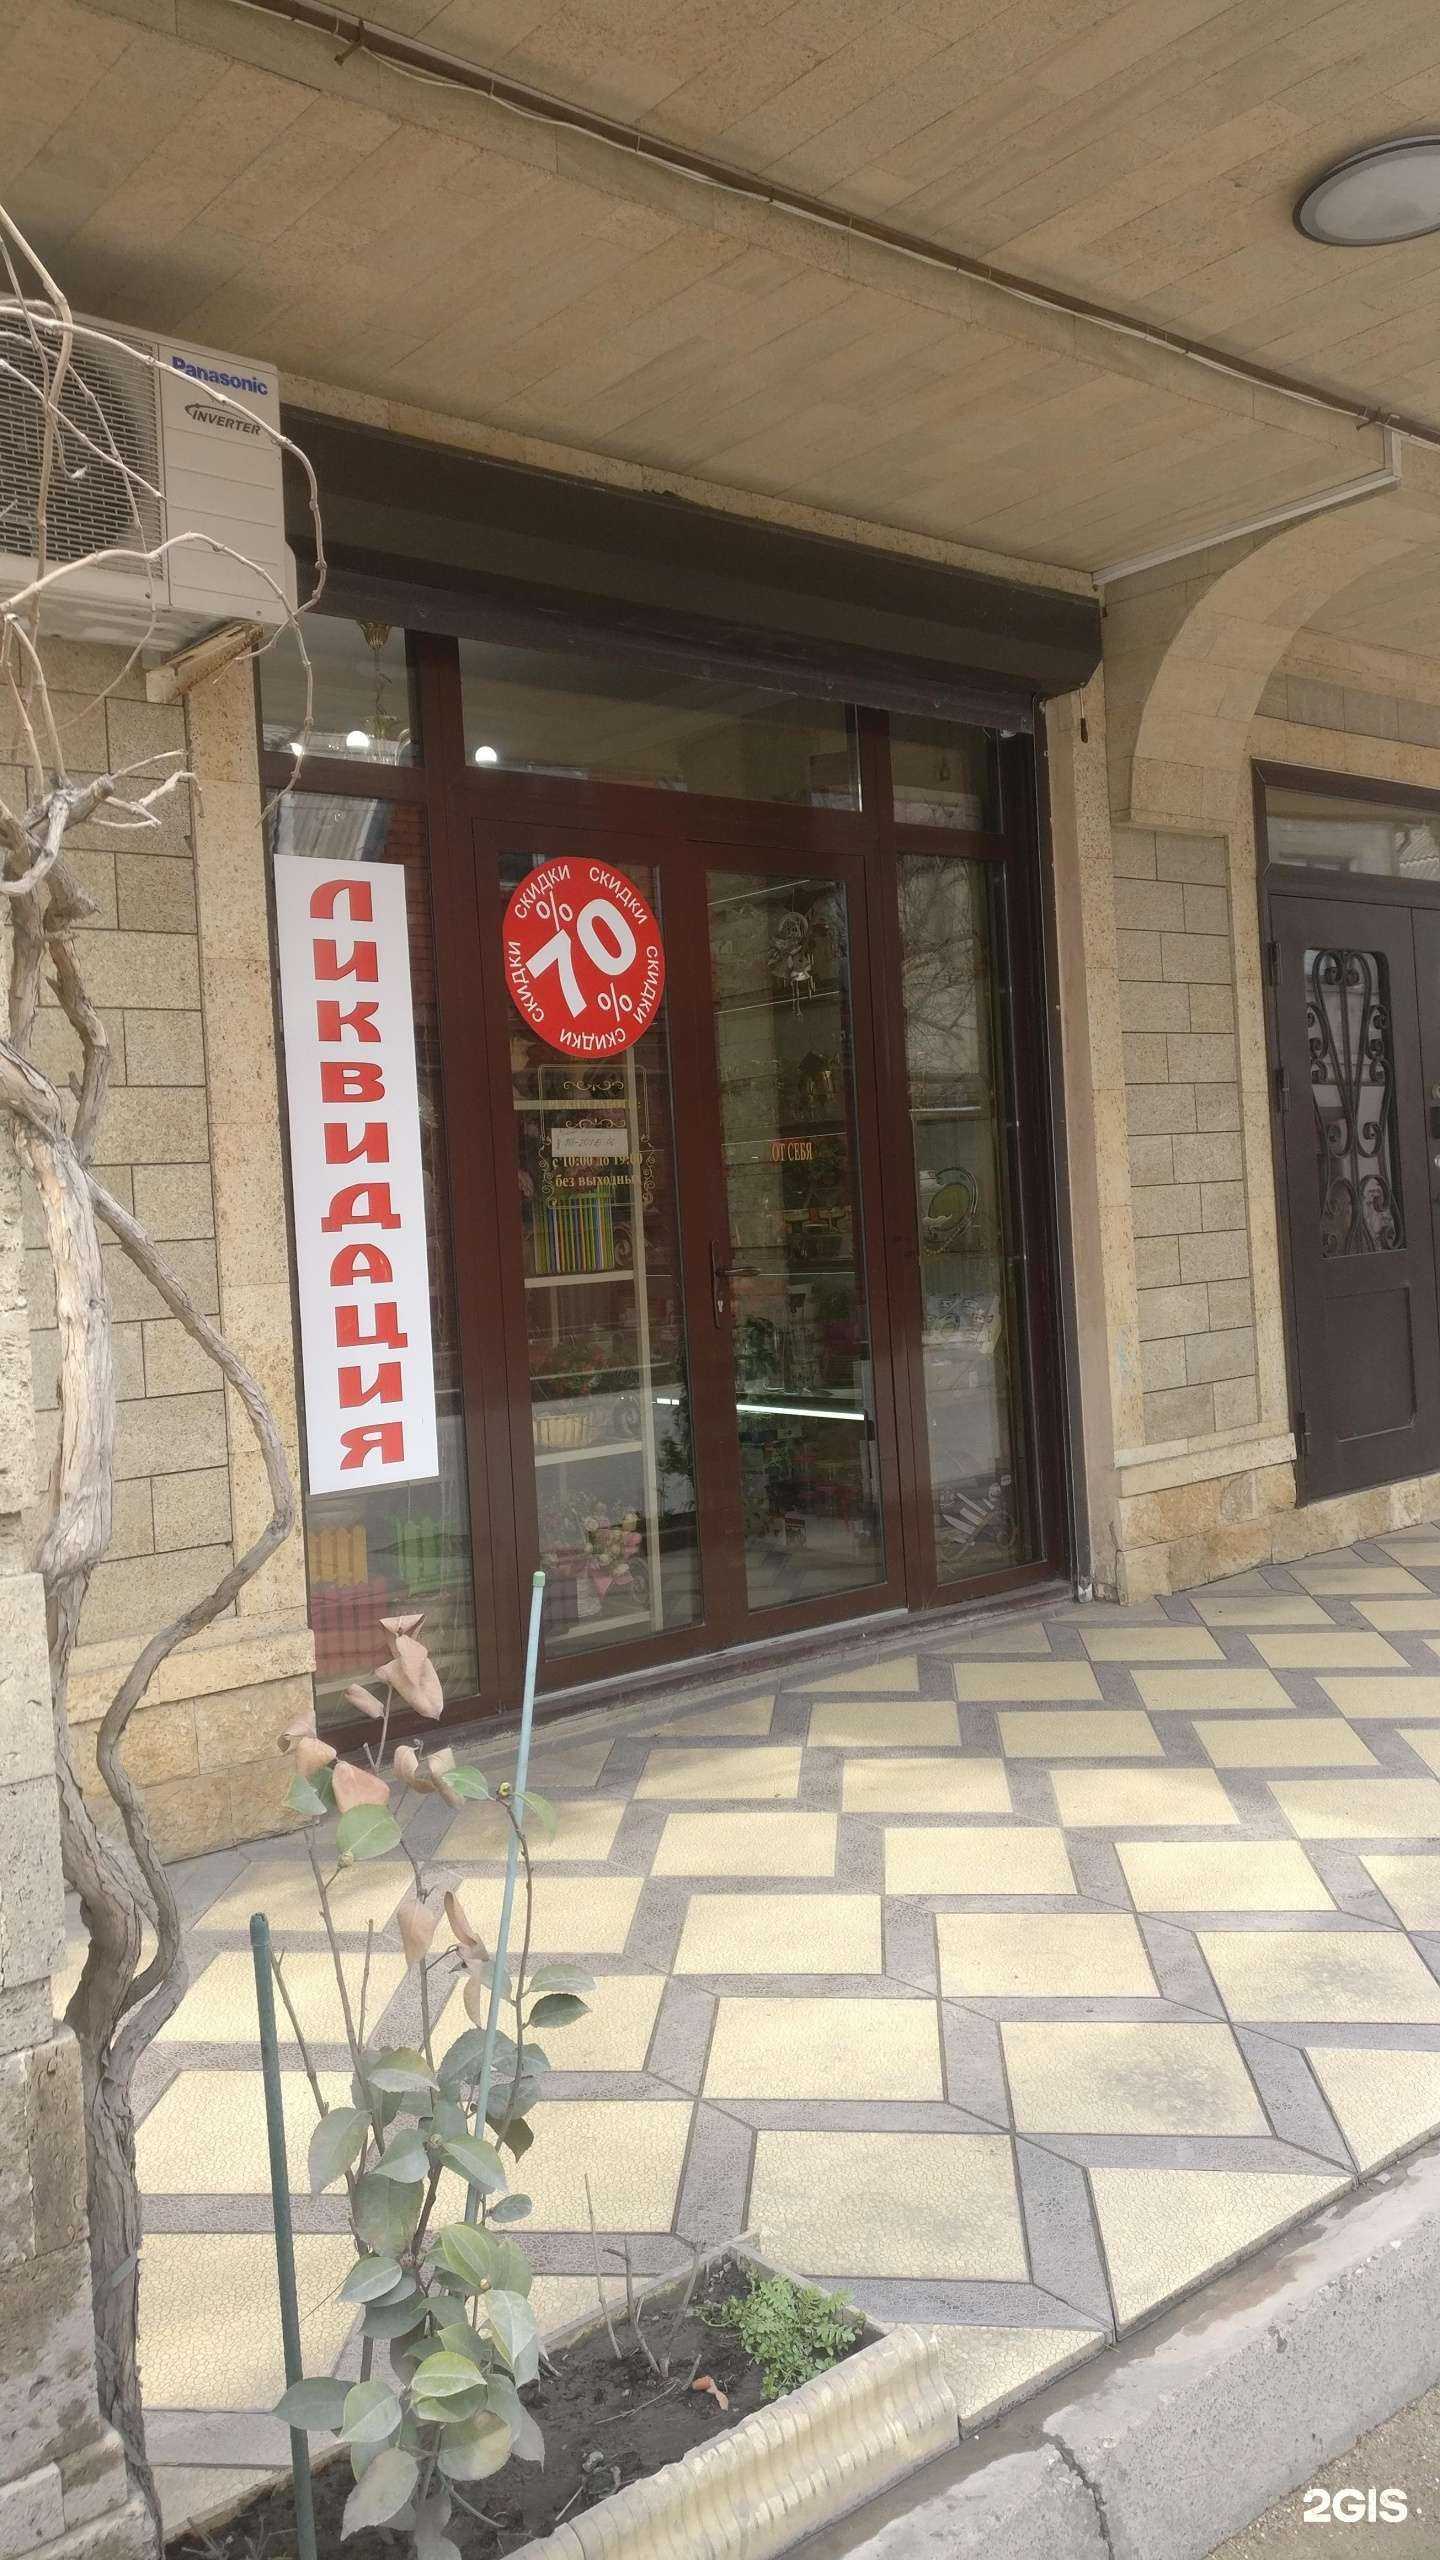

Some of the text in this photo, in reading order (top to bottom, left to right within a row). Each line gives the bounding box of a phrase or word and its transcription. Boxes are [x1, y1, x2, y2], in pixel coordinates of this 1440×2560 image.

[172, 355, 269, 396] Panasonic
[192, 410, 262, 435] INVERTER
[514, 864, 571, 919] СКИДКИ
[589, 866, 649, 925] СКИДКИ
[508, 941, 545, 1023] СКИДКИ
[633, 945, 660, 1025] СКИДКИ
[559, 1027, 626, 1051] СКИДКИ
[309, 879, 408, 1471] ЛИКВИДАЦИЯ
[771, 1142, 813, 1161] ОТ СЕБЯ
[555, 1174, 575, 1187] без
